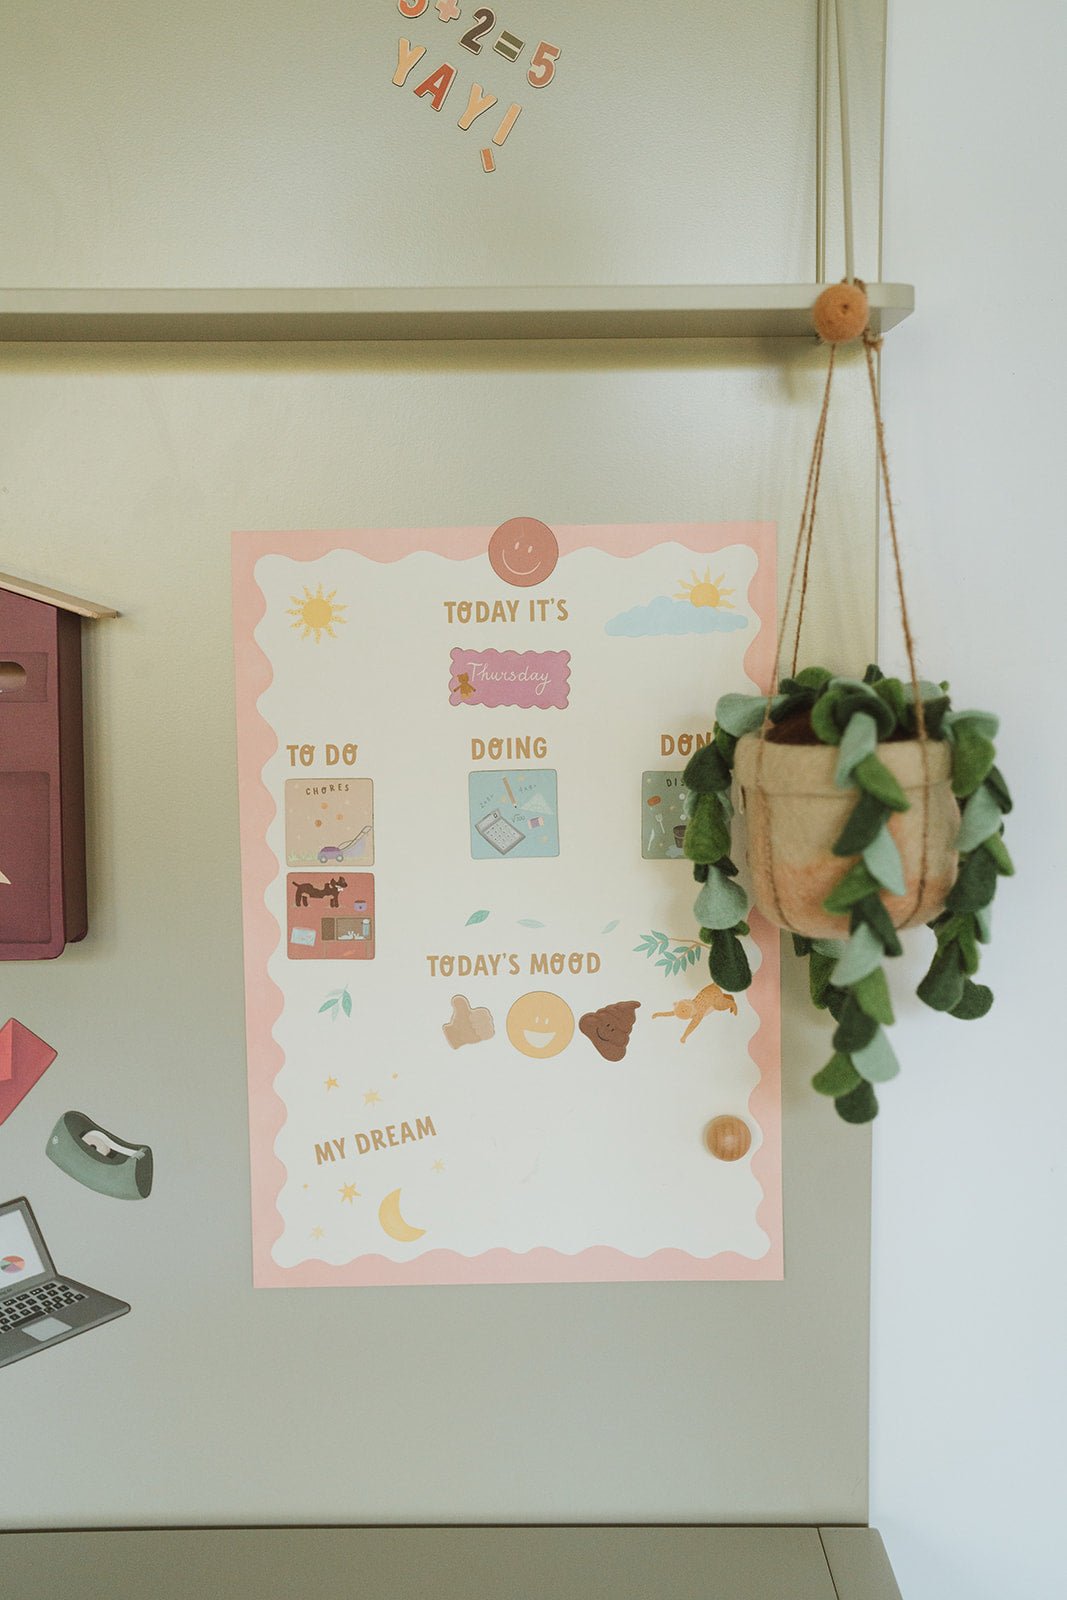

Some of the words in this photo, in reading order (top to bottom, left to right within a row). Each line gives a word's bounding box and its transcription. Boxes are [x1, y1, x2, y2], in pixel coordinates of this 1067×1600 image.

[444, 600, 520, 624] TODAY
[529, 598, 569, 622] IT'S
[466, 662, 552, 696] Thursday
[286, 744, 316, 767] TO
[325, 743, 359, 767] DO
[471, 736, 547, 760] DOING
[661, 732, 712, 756] DON
[305, 783, 350, 795] CHORES
[426, 953, 520, 977] TODAY'S
[530, 952, 601, 975] MOOD
[314, 1137, 346, 1165] MY
[355, 1116, 437, 1155] DREAM
